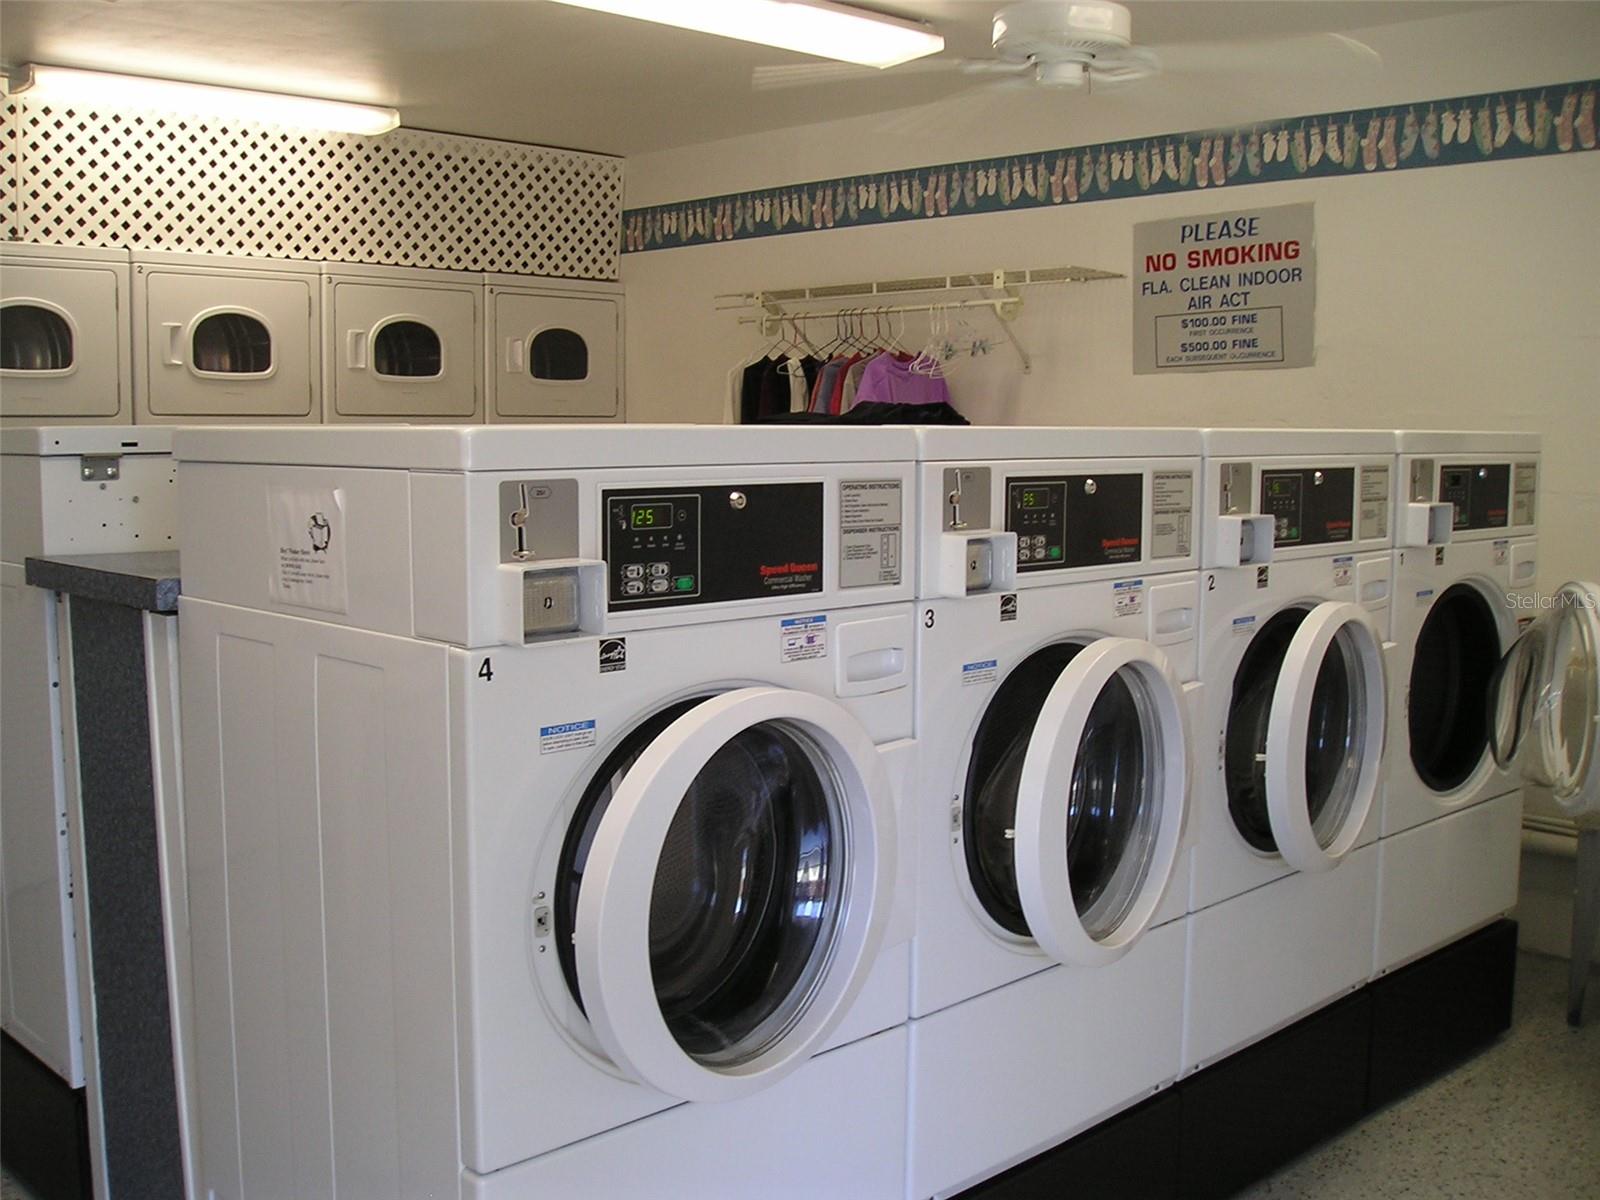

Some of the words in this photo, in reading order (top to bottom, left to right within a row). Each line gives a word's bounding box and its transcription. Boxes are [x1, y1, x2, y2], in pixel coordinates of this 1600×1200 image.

[1181, 217, 1260, 243] PLEASE
[1146, 253, 1176, 272] NO
[1187, 240, 1300, 269] SMOKING
[137, 265, 143, 274] 2
[1142, 281, 1172, 296] FLA.
[1180, 274, 1230, 292] CLEAN
[1238, 267, 1302, 287] INDOOR
[1188, 296, 1211, 310] AIR
[1220, 292, 1251, 308] ACT
[1181, 316, 1227, 329] $100.00
[1231, 313, 1258, 325] FINE
[1180, 340, 1228, 353] $500.00
[1232, 338, 1259, 349] FINE
[1208, 574, 1216, 591] 2
[925, 609, 935, 628] 3
[478, 657, 493, 681] 4
[548, 721, 590, 735] NOTICE
